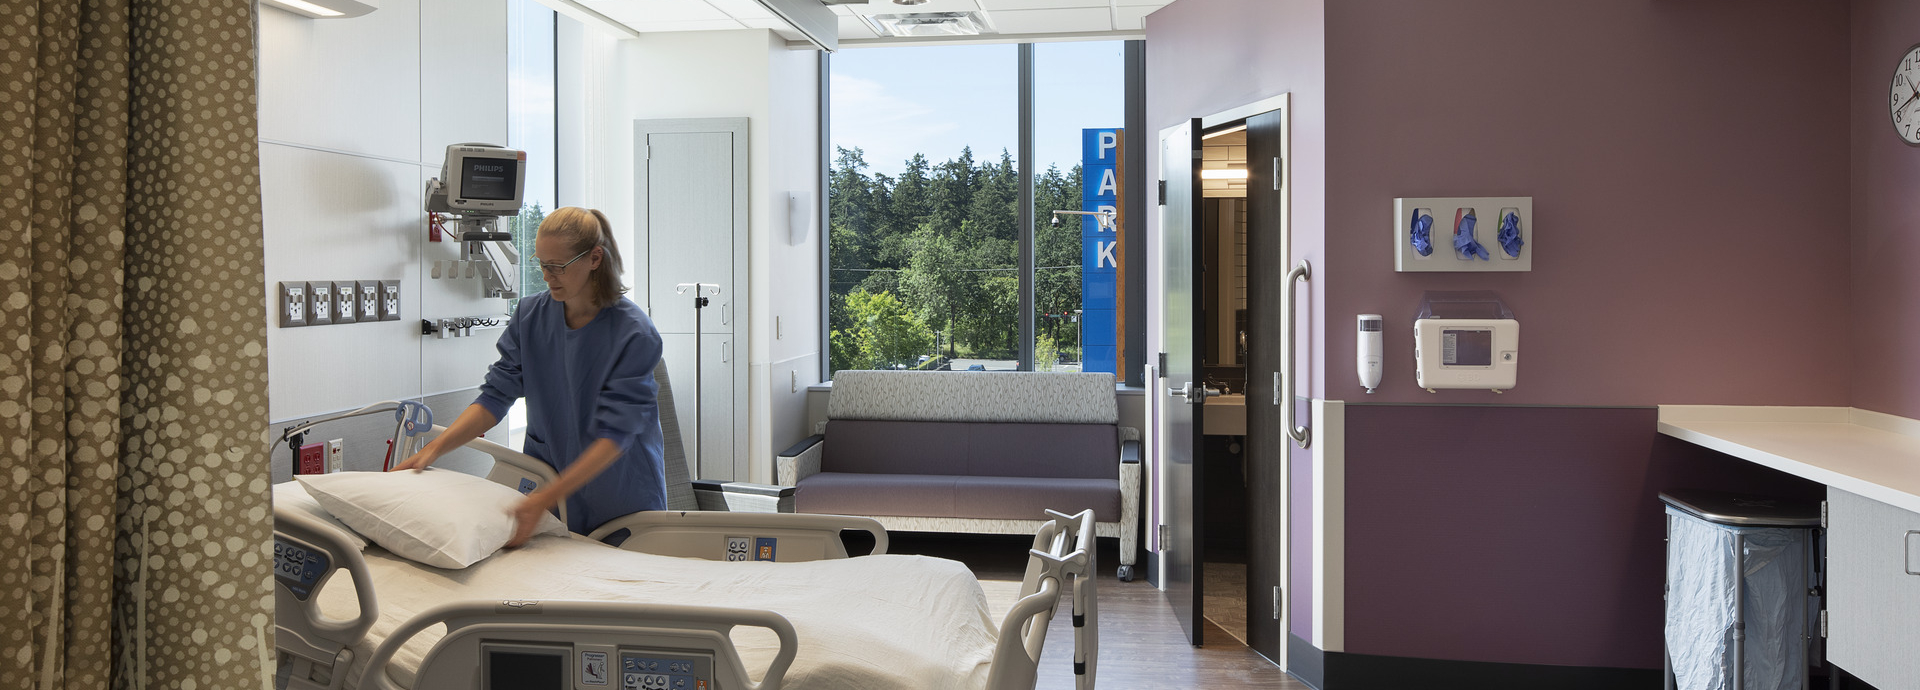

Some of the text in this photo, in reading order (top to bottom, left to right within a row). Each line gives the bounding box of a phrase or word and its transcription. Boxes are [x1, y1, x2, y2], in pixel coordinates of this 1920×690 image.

[1915, 50, 1920, 63] 1
[1905, 58, 1911, 71] 11
[1895, 73, 1903, 87] 10
[1893, 93, 1899, 106] 9
[1896, 110, 1902, 123] 8
[1904, 124, 1911, 138] 7
[473, 164, 504, 173] PHILIPS
[1097, 132, 1116, 268] PARK
